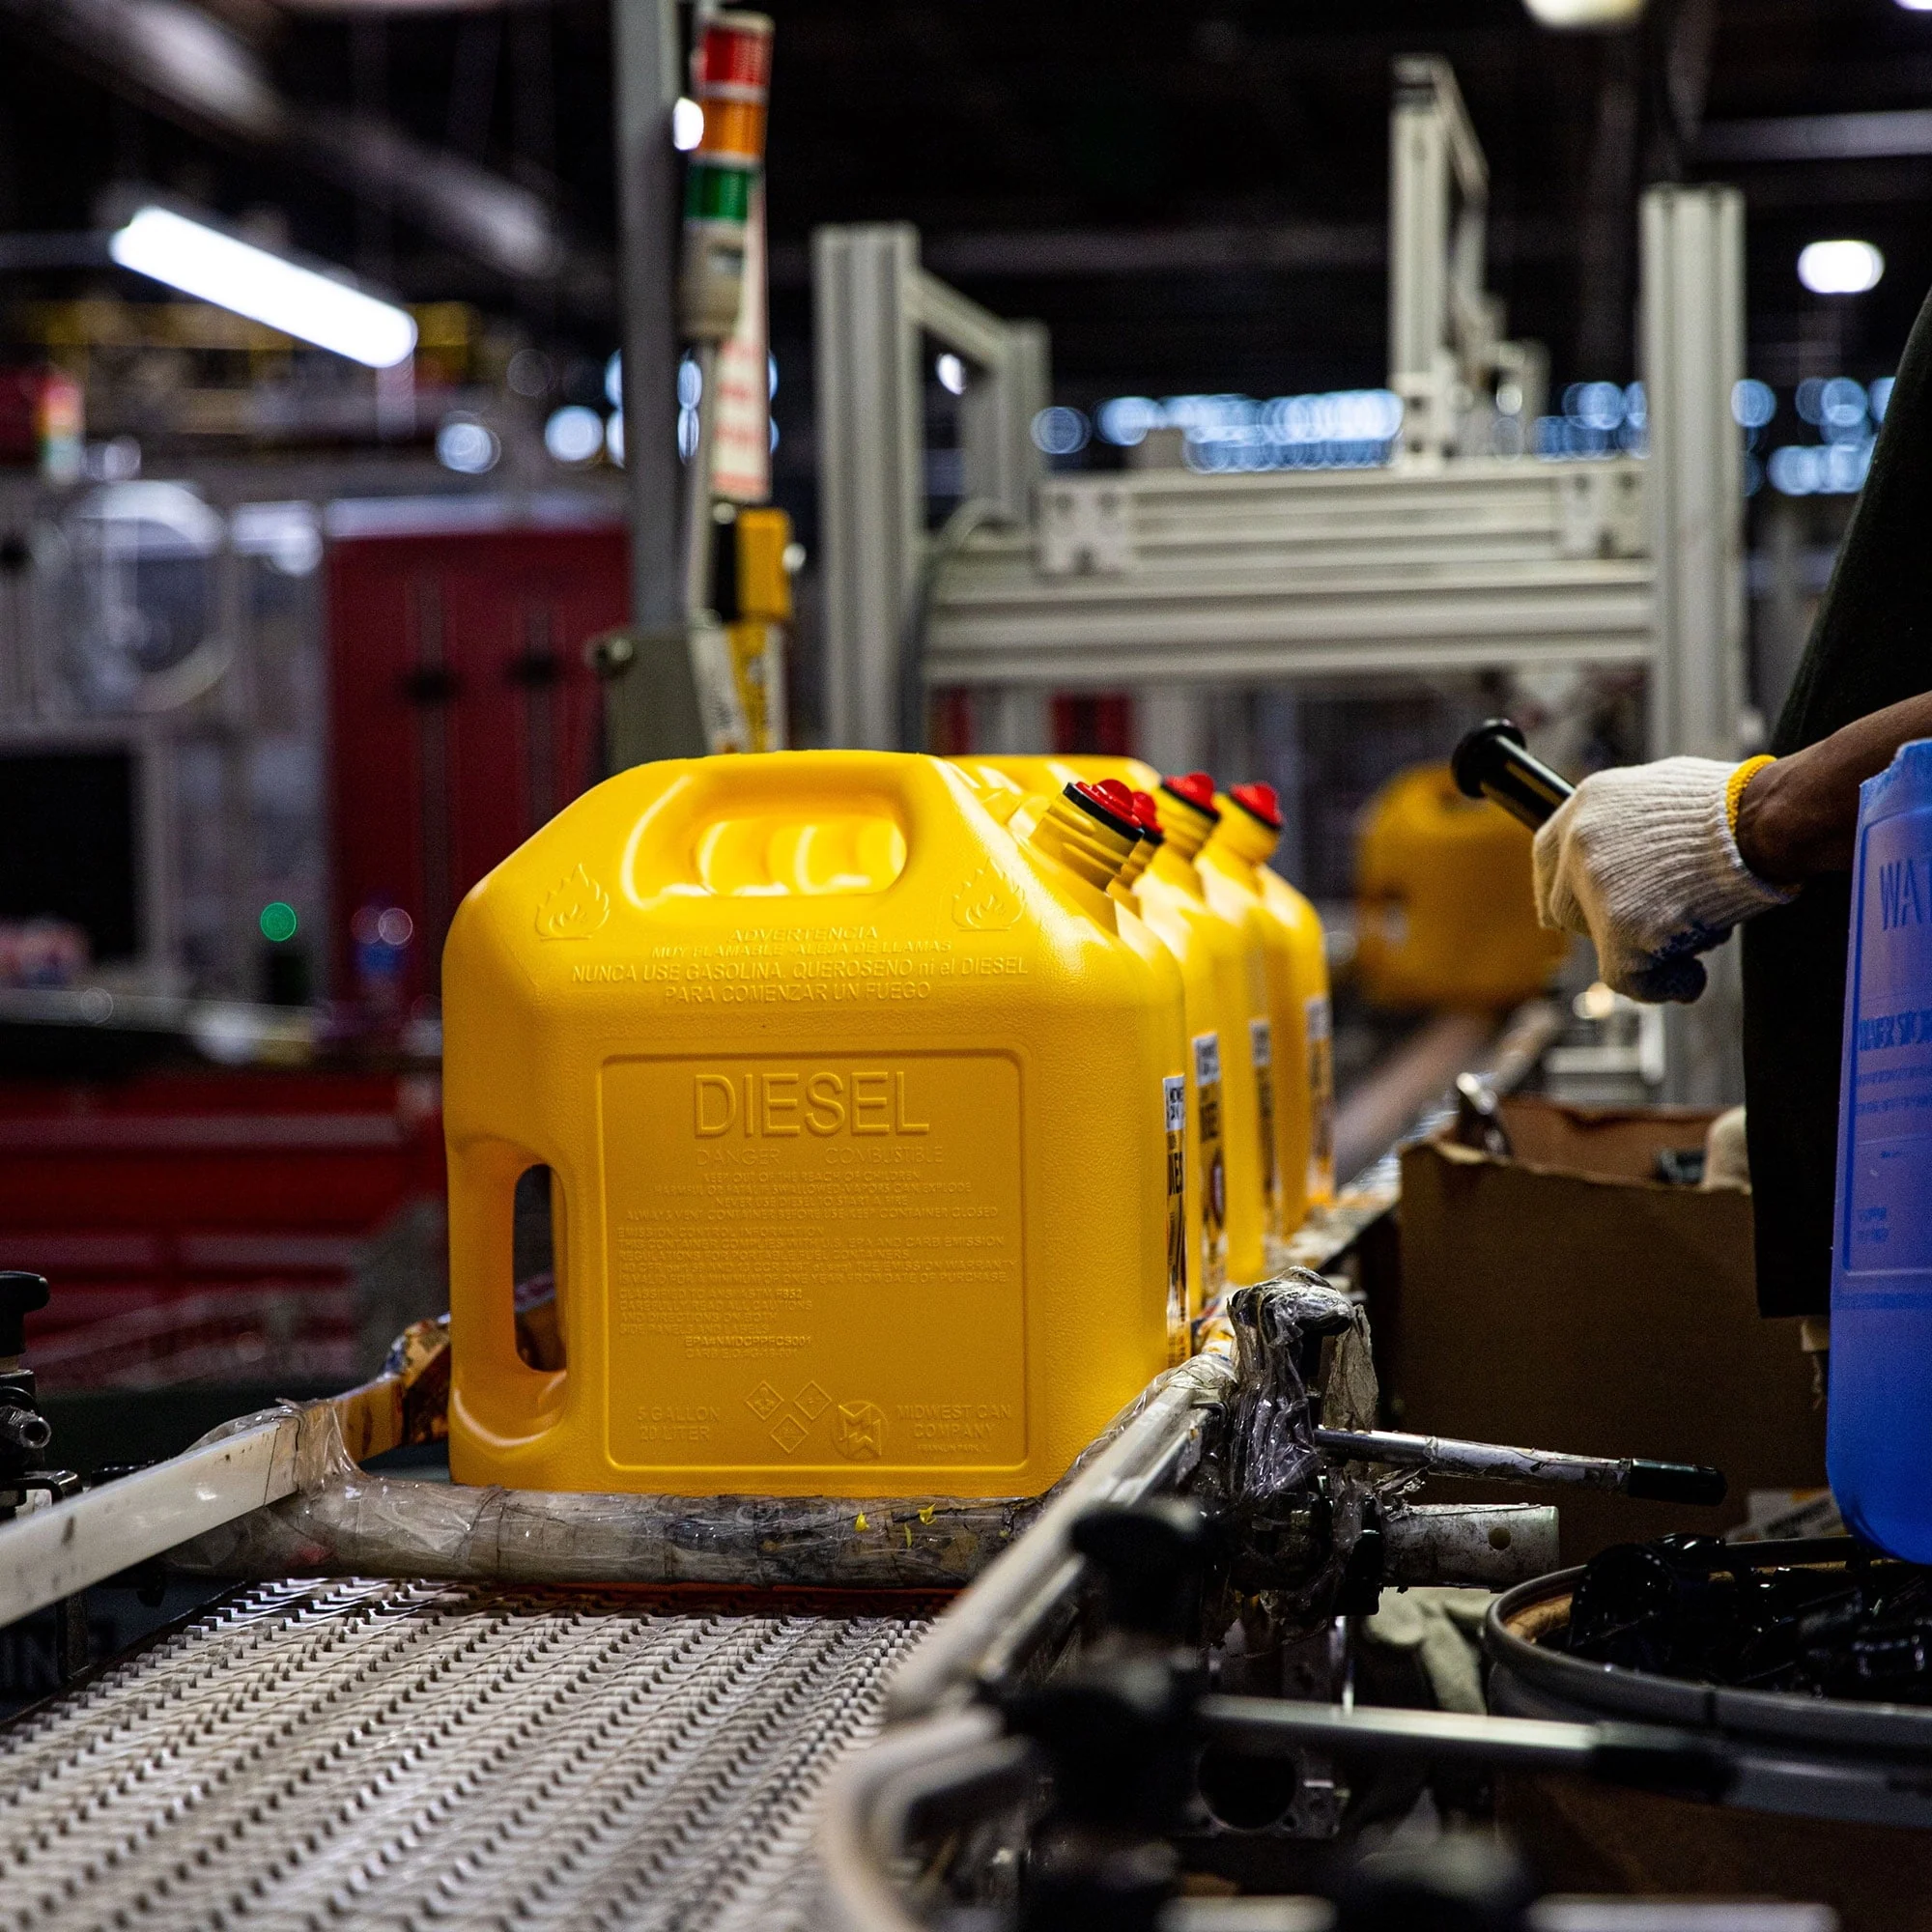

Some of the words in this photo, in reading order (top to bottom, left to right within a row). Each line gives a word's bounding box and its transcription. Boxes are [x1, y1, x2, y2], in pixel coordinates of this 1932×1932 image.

[727, 924, 878, 945] ADVERTENCIA
[651, 945, 688, 960] MUY
[692, 943, 783, 958] FLAMABLE
[853, 940, 878, 954] DE
[881, 939, 952, 954] LLAMAS
[571, 963, 638, 984] NUNCA
[643, 963, 681, 983] USE
[792, 958, 914, 980] QUEROSENO
[918, 956, 935, 977] ni
[939, 956, 955, 977] el
[960, 955, 1029, 977] DIESEL
[664, 984, 716, 1004] PARA
[720, 982, 829, 1004] COMENZAR
[833, 981, 861, 1002] UN
[867, 980, 932, 1001] FUEGO
[695, 1070, 930, 1138] DIESEL
[696, 1147, 781, 1167] DANGER
[824, 1145, 944, 1166] COMBUSTIBLE
[637, 1406, 647, 1421] 5
[650, 1405, 721, 1423] GALLON
[895, 1404, 972, 1420] MIDWEST
[976, 1404, 1012, 1420] CAN
[639, 1426, 658, 1442] 20
[662, 1425, 712, 1442] LITER
[913, 1422, 996, 1439] COMPANY
